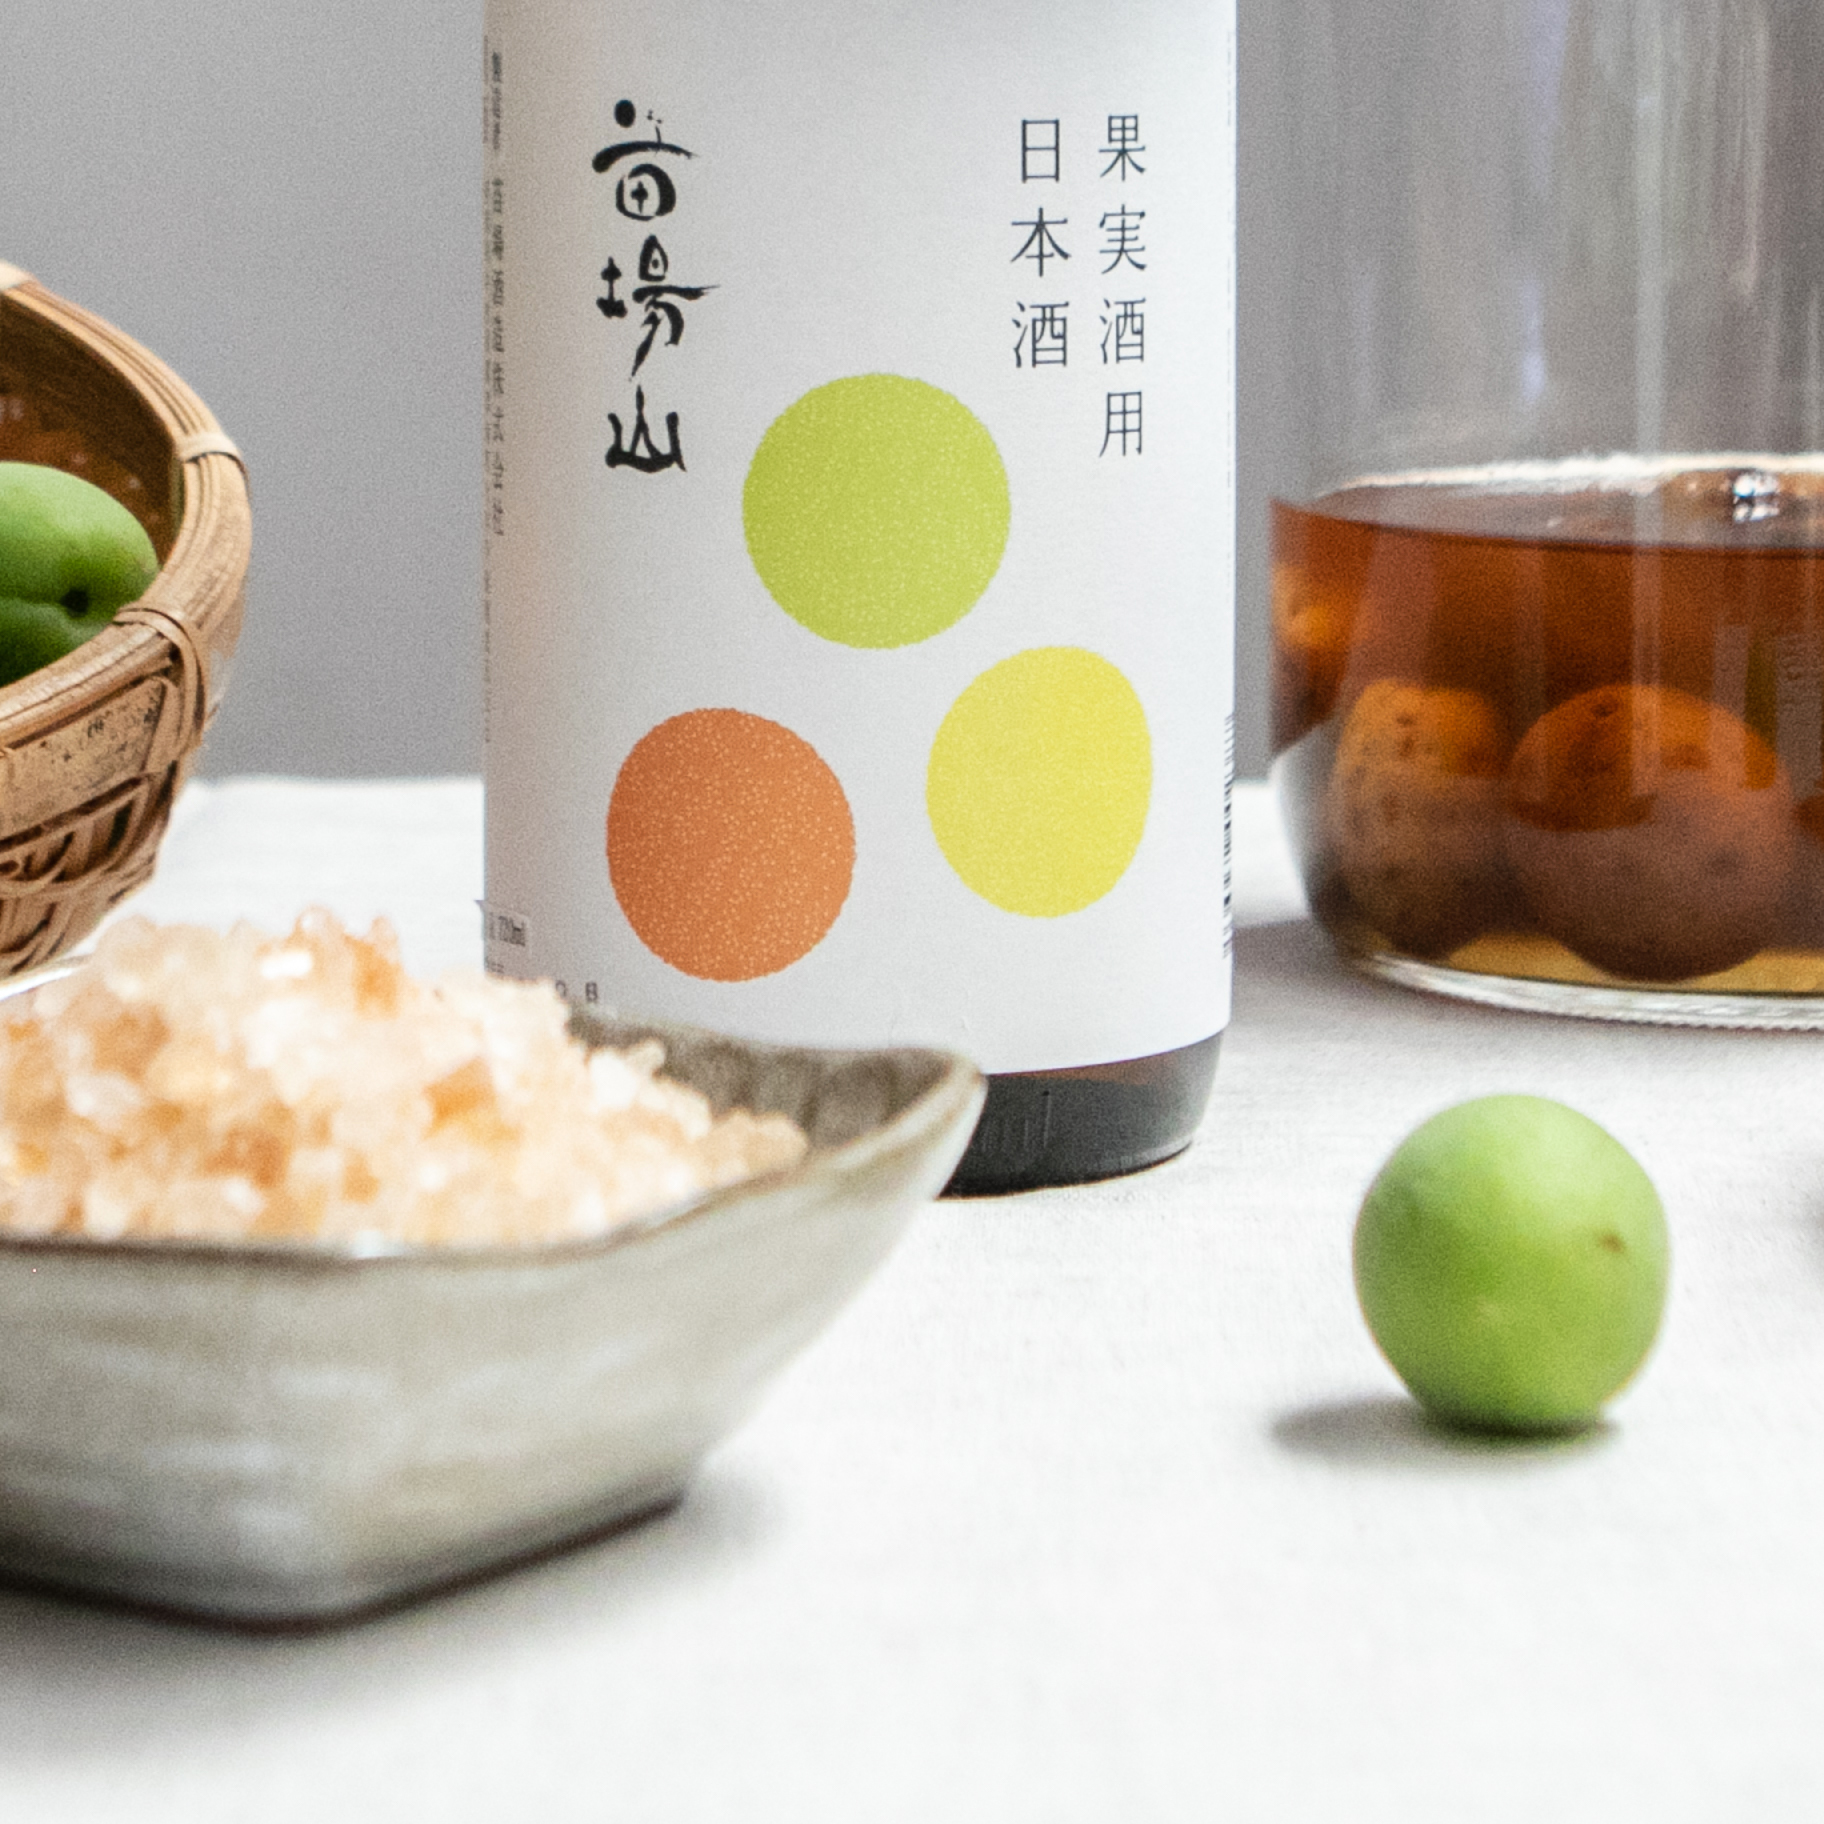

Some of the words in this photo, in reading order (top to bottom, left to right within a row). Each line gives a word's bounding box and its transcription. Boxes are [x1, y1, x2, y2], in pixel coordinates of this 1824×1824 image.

[1009, 118, 1073, 369] 日本酒
[1097, 113, 1148, 459] 果実酒用
